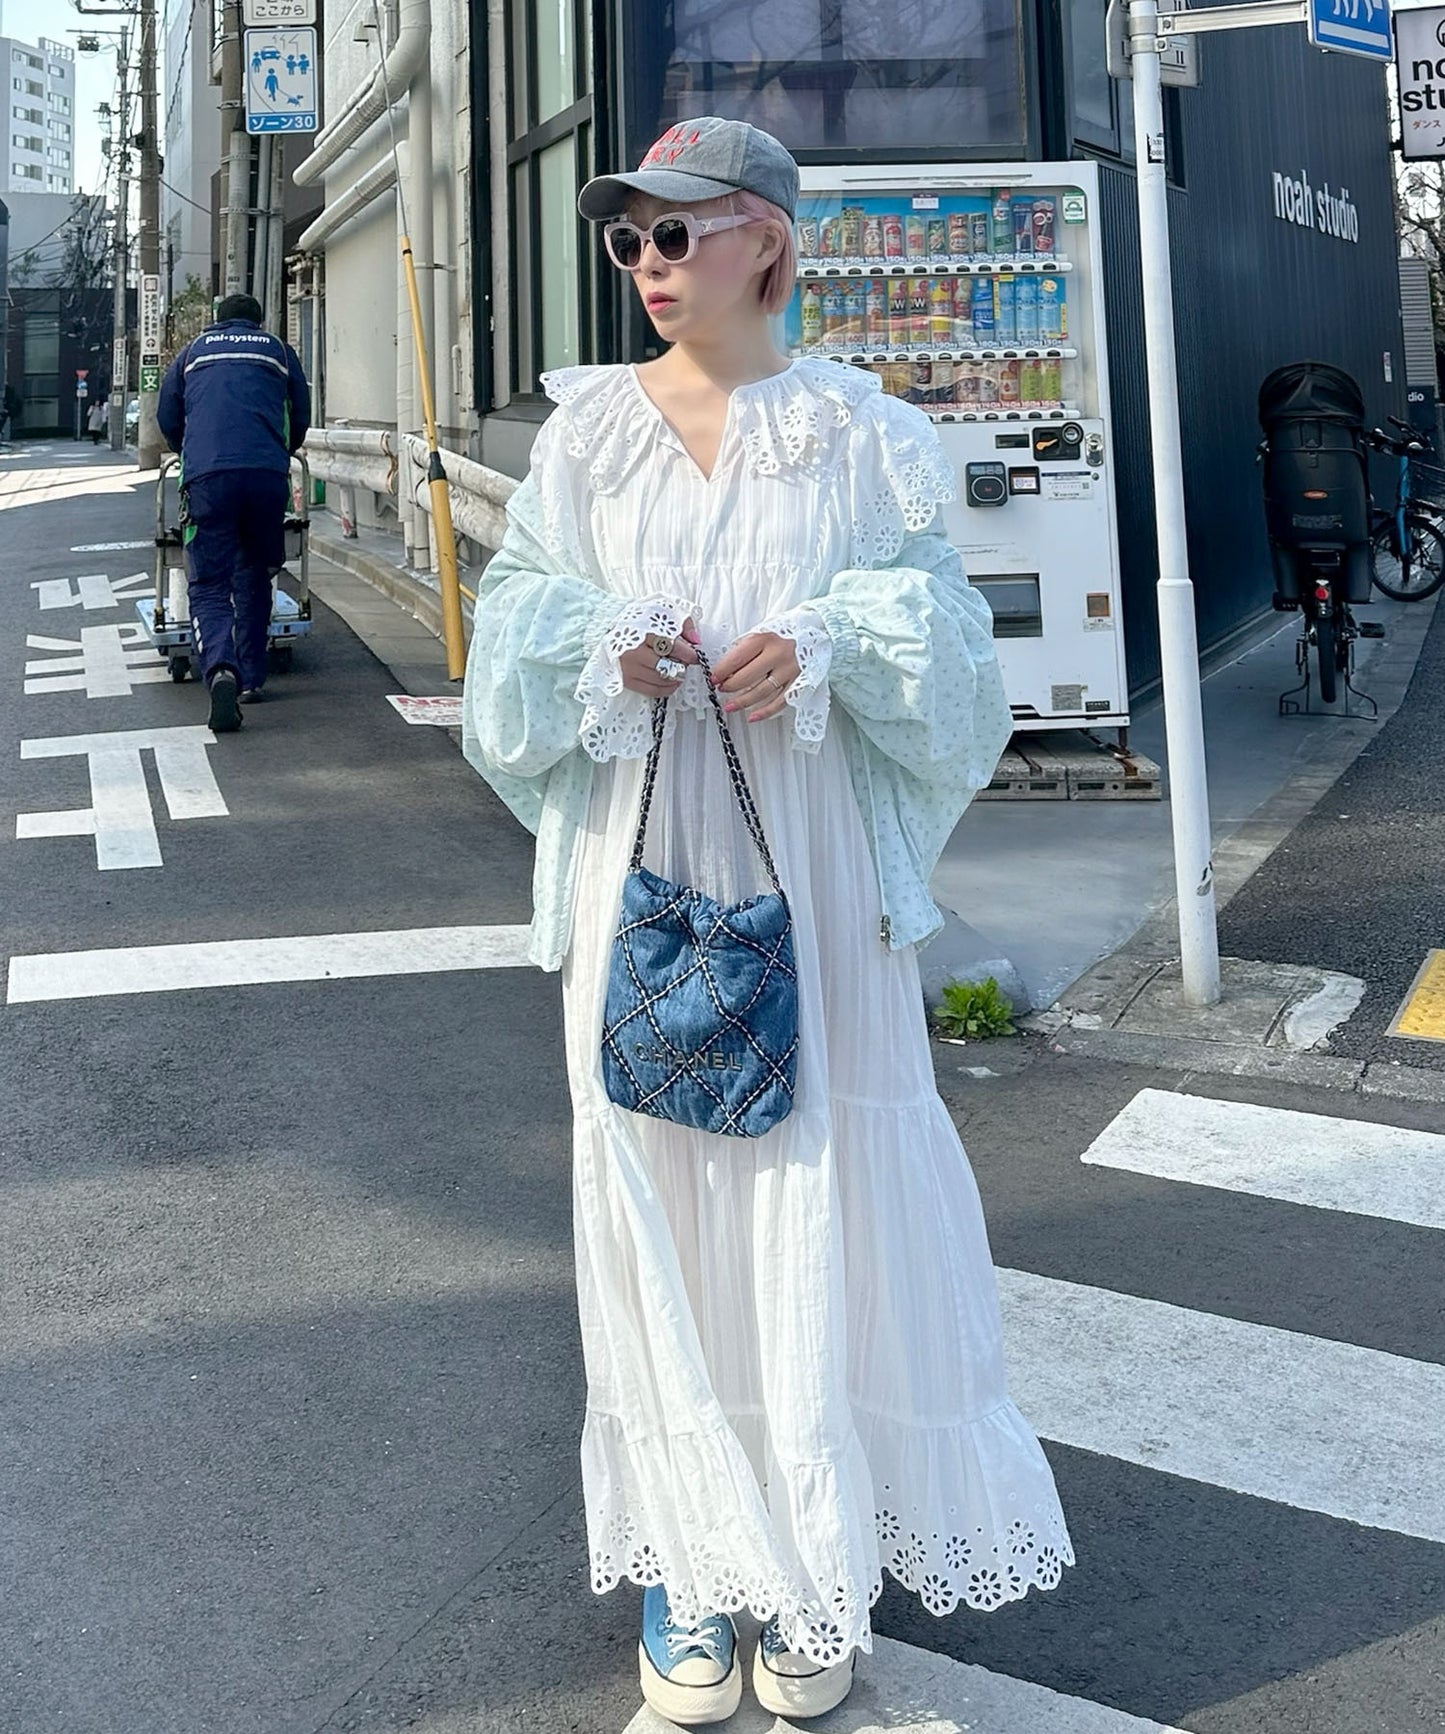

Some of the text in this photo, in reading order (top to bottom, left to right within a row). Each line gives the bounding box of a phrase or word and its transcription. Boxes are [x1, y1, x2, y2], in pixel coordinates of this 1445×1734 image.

[255, 5, 305, 17] ここから
[1272, 169, 1358, 243] noah studio
[143, 375, 158, 389] 文
[633, 1041, 743, 1073] CHANEL
